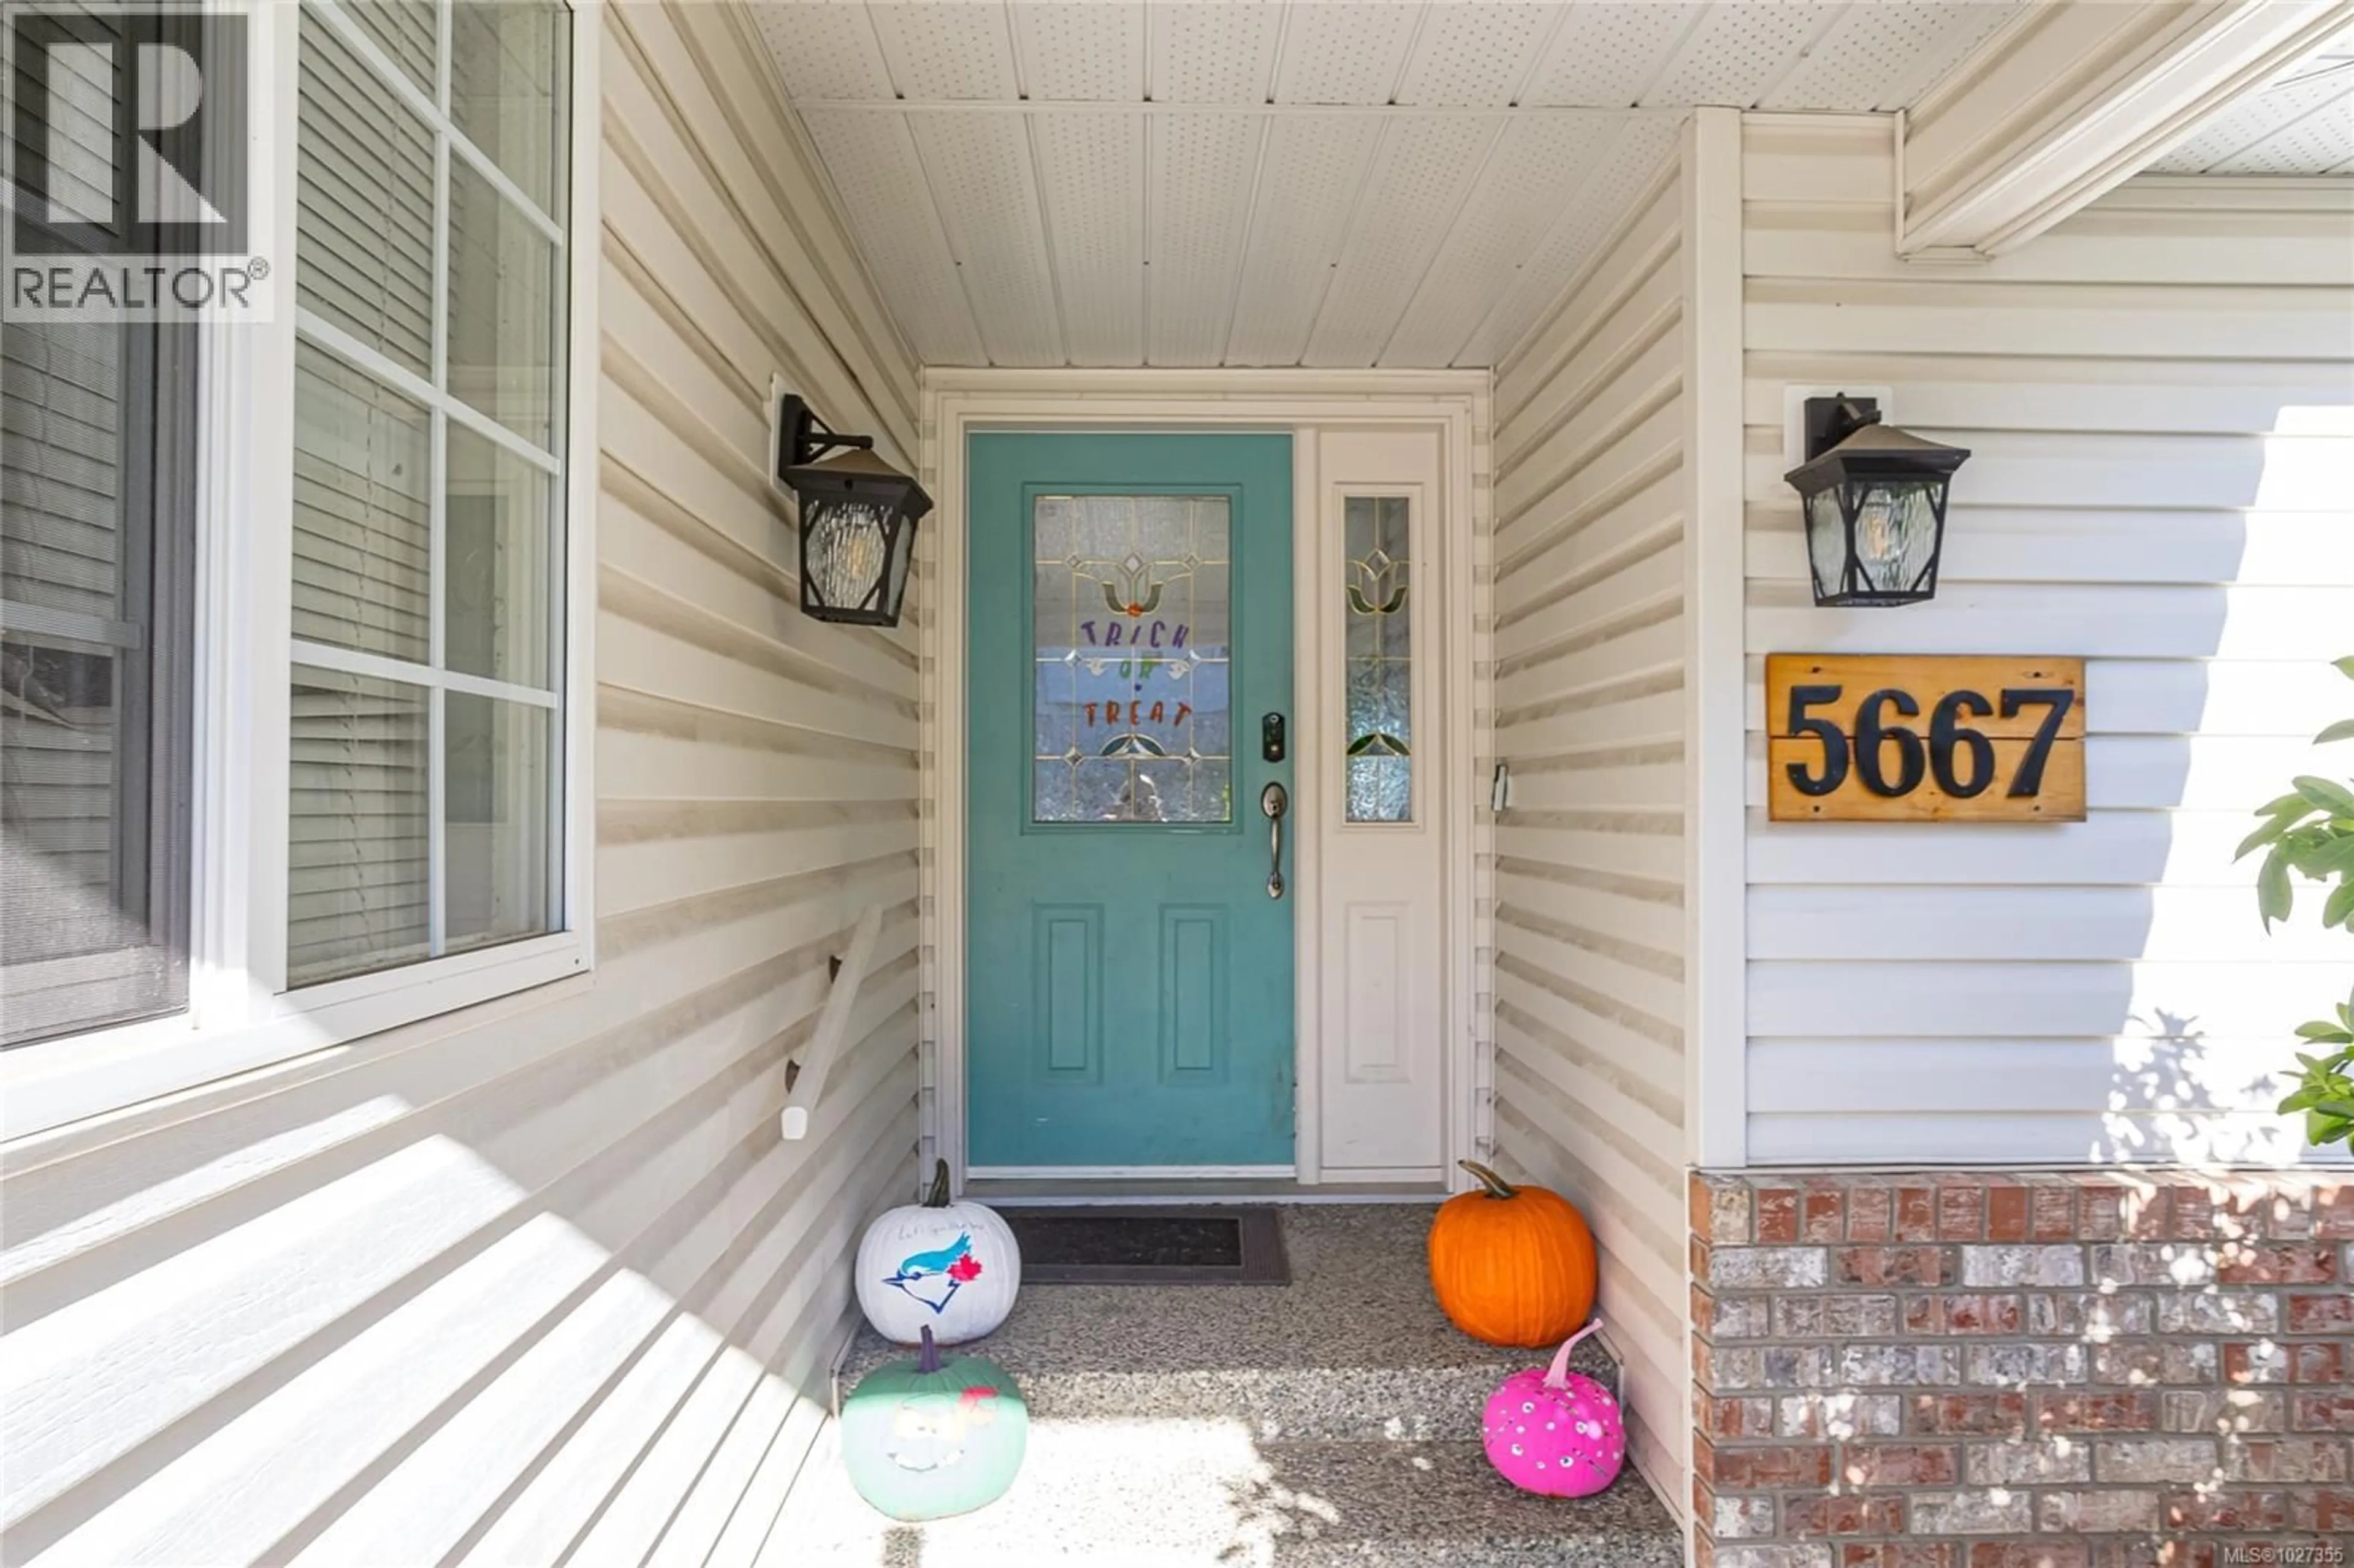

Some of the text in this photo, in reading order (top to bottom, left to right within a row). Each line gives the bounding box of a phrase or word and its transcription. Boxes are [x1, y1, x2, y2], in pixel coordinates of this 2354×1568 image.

[1080, 620, 1189, 649] TRICK
[1084, 700, 1191, 727] TREAT
[1786, 684, 2074, 799] 5667
